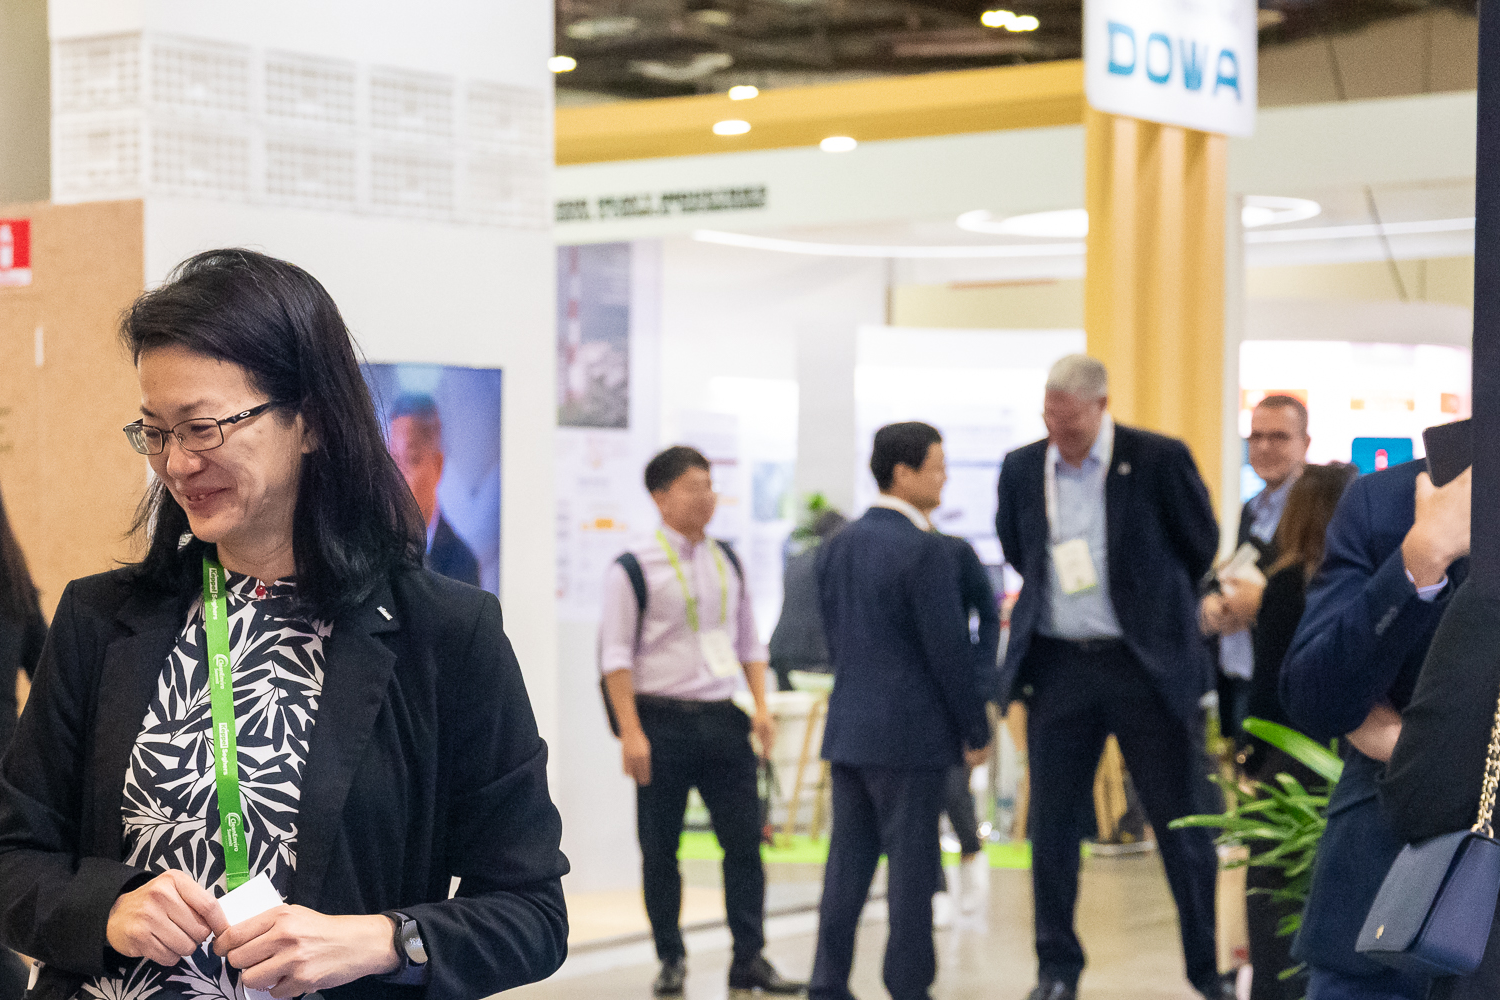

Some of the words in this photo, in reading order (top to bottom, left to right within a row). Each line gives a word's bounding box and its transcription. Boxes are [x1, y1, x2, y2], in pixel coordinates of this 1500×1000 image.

[1107, 21, 1241, 101] DOWA
[220, 723, 228, 748] Keppel
[230, 817, 239, 852] CleanEnviro
